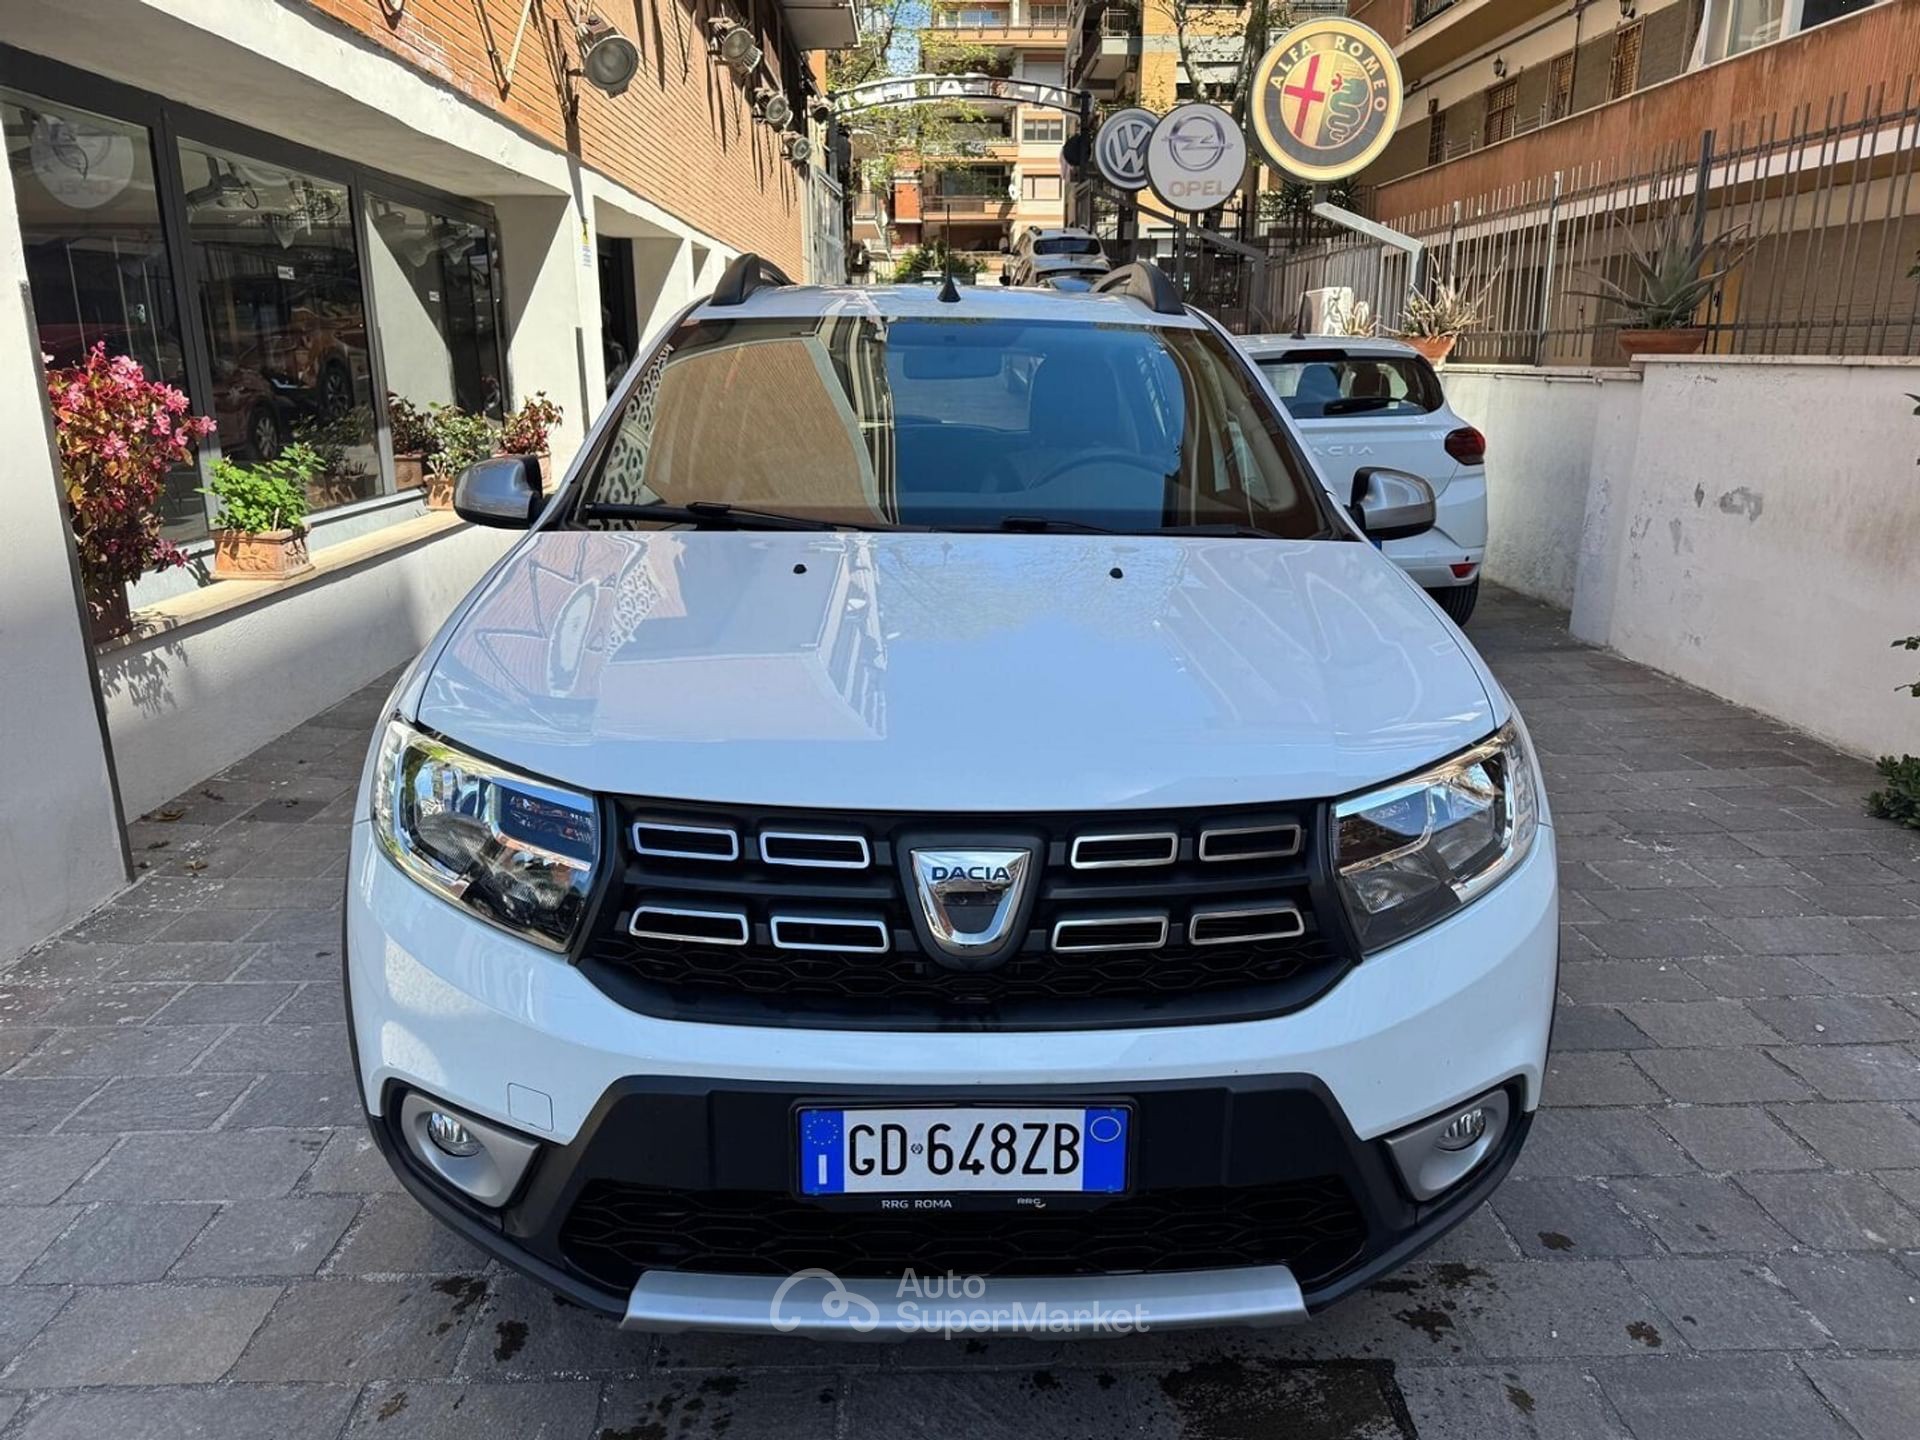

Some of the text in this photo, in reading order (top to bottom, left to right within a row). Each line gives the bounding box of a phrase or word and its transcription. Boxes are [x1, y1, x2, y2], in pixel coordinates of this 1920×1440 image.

[1270, 35, 1388, 112] ALFA ROMEO
[1168, 180, 1229, 197] OPEL
[1310, 445, 1375, 457] ACIA
[931, 866, 1011, 881] DACIA
[881, 1199, 953, 1209] RRG ROMA
